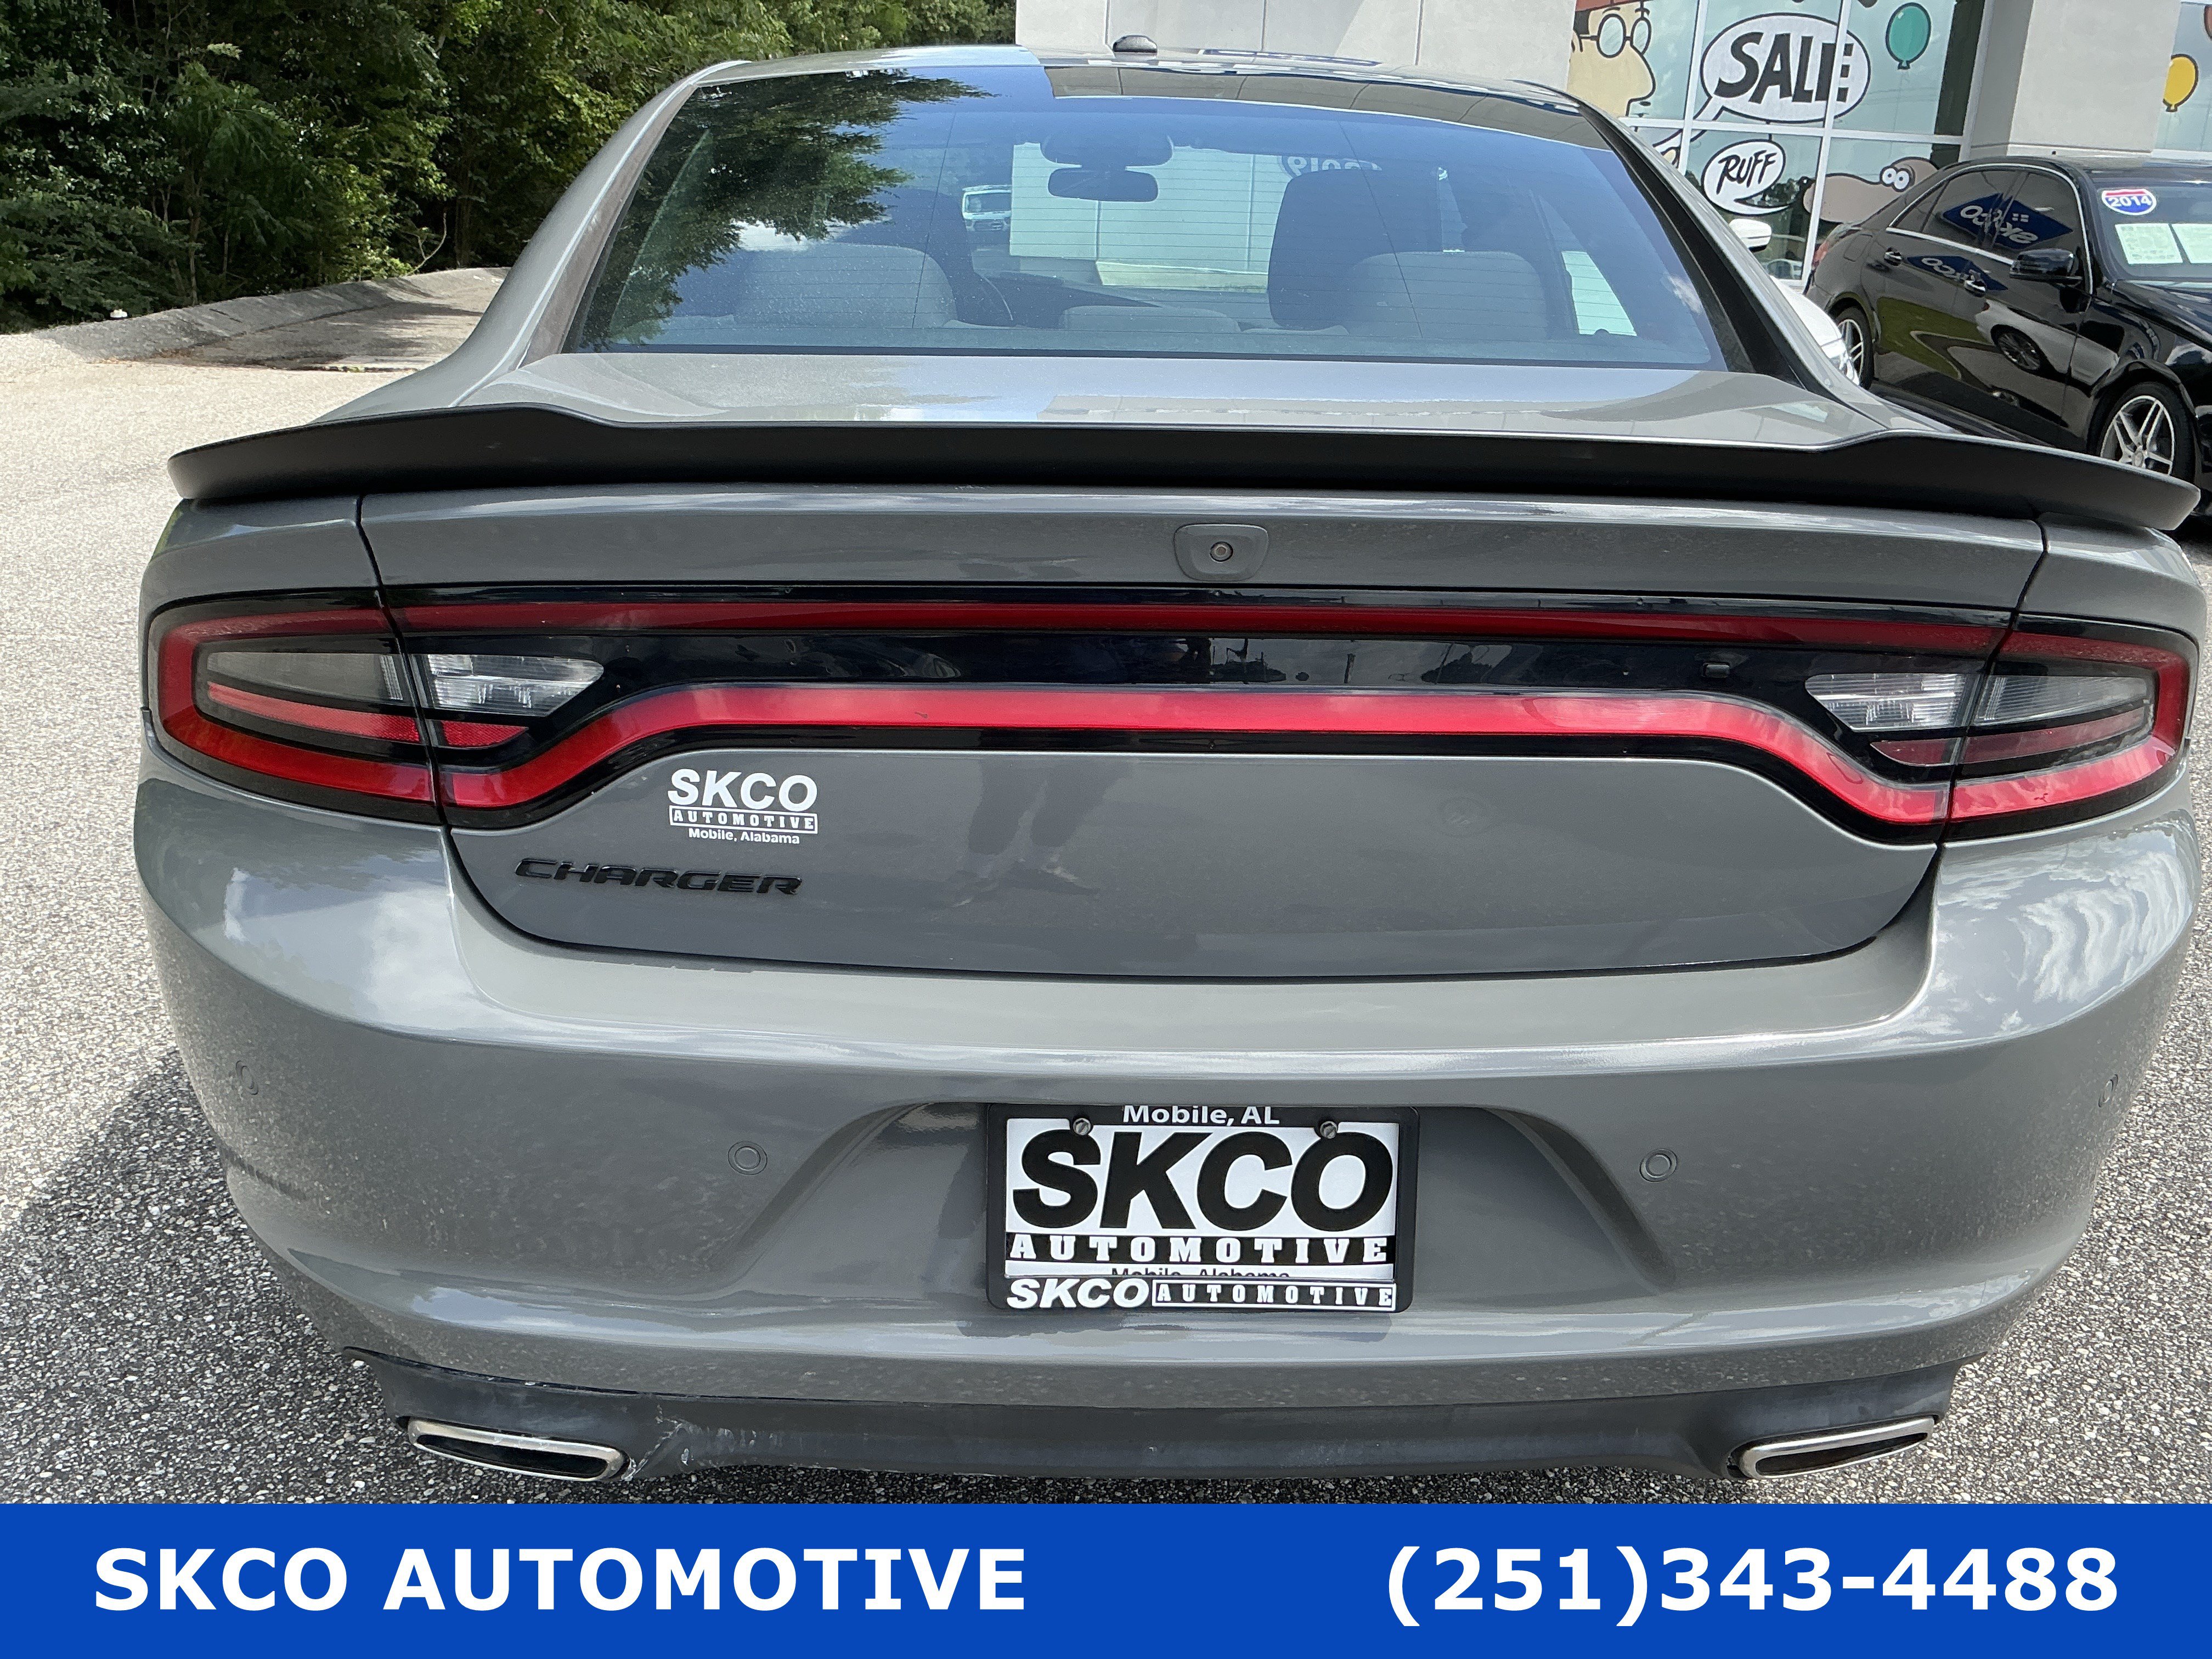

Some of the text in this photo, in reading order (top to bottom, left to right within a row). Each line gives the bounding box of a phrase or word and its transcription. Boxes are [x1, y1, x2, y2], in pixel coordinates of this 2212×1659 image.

[1714, 32, 1853, 104] SALE
[1715, 150, 1777, 195] RUFF
[2108, 195, 2152, 207] 2014
[668, 768, 817, 811] SKCO
[674, 809, 814, 830] AUTOMOTIVE
[689, 828, 800, 844] Mobile, Alabama
[515, 857, 803, 895] CHARGER
[1123, 1105, 1280, 1126] Mobile, AL
[1013, 1128, 1393, 1232] SKCO
[1010, 1234, 1387, 1264] AUTOMOTIVE
[1007, 1278, 1392, 1309] SKCO AUTOMOTIVE
